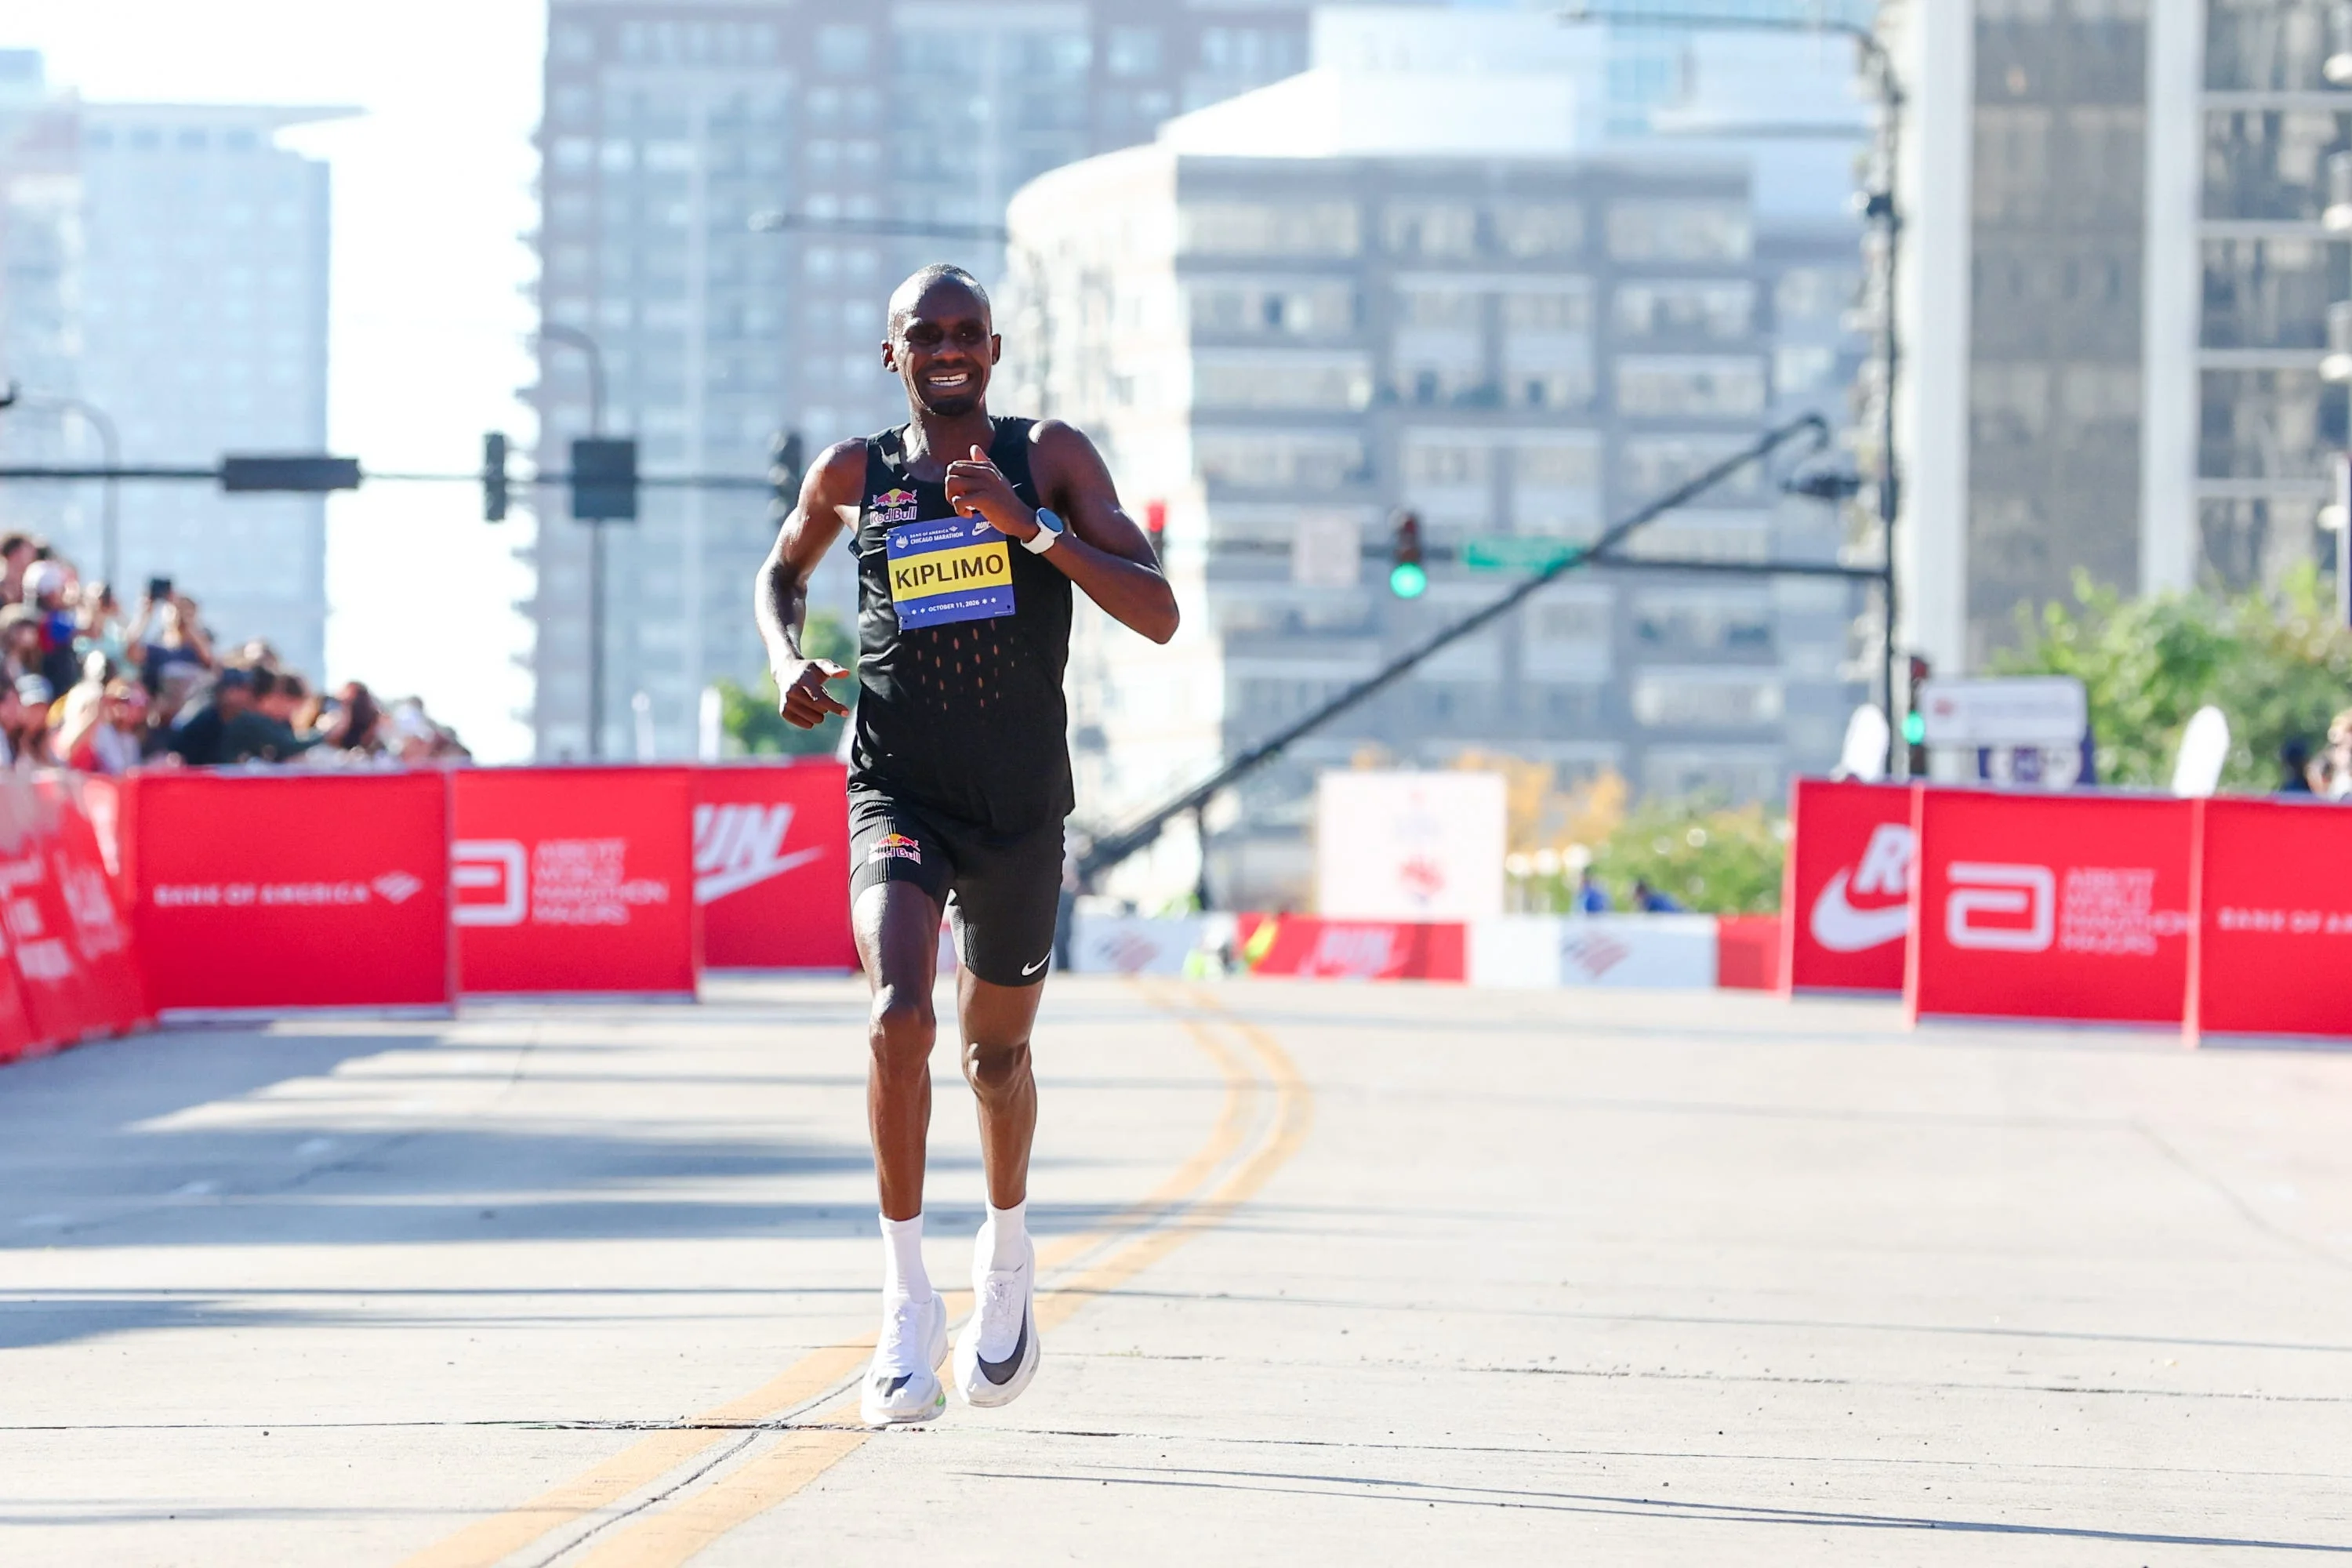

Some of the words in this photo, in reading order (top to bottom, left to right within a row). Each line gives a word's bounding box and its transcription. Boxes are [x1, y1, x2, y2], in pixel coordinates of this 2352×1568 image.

[870, 508, 892, 524] Red
[892, 506, 917, 521] Bull
[934, 532, 964, 541] MARATHON
[895, 554, 1004, 590] KIPLIMO
[928, 604, 955, 612] OCTOBER
[896, 847, 921, 865] Bull
